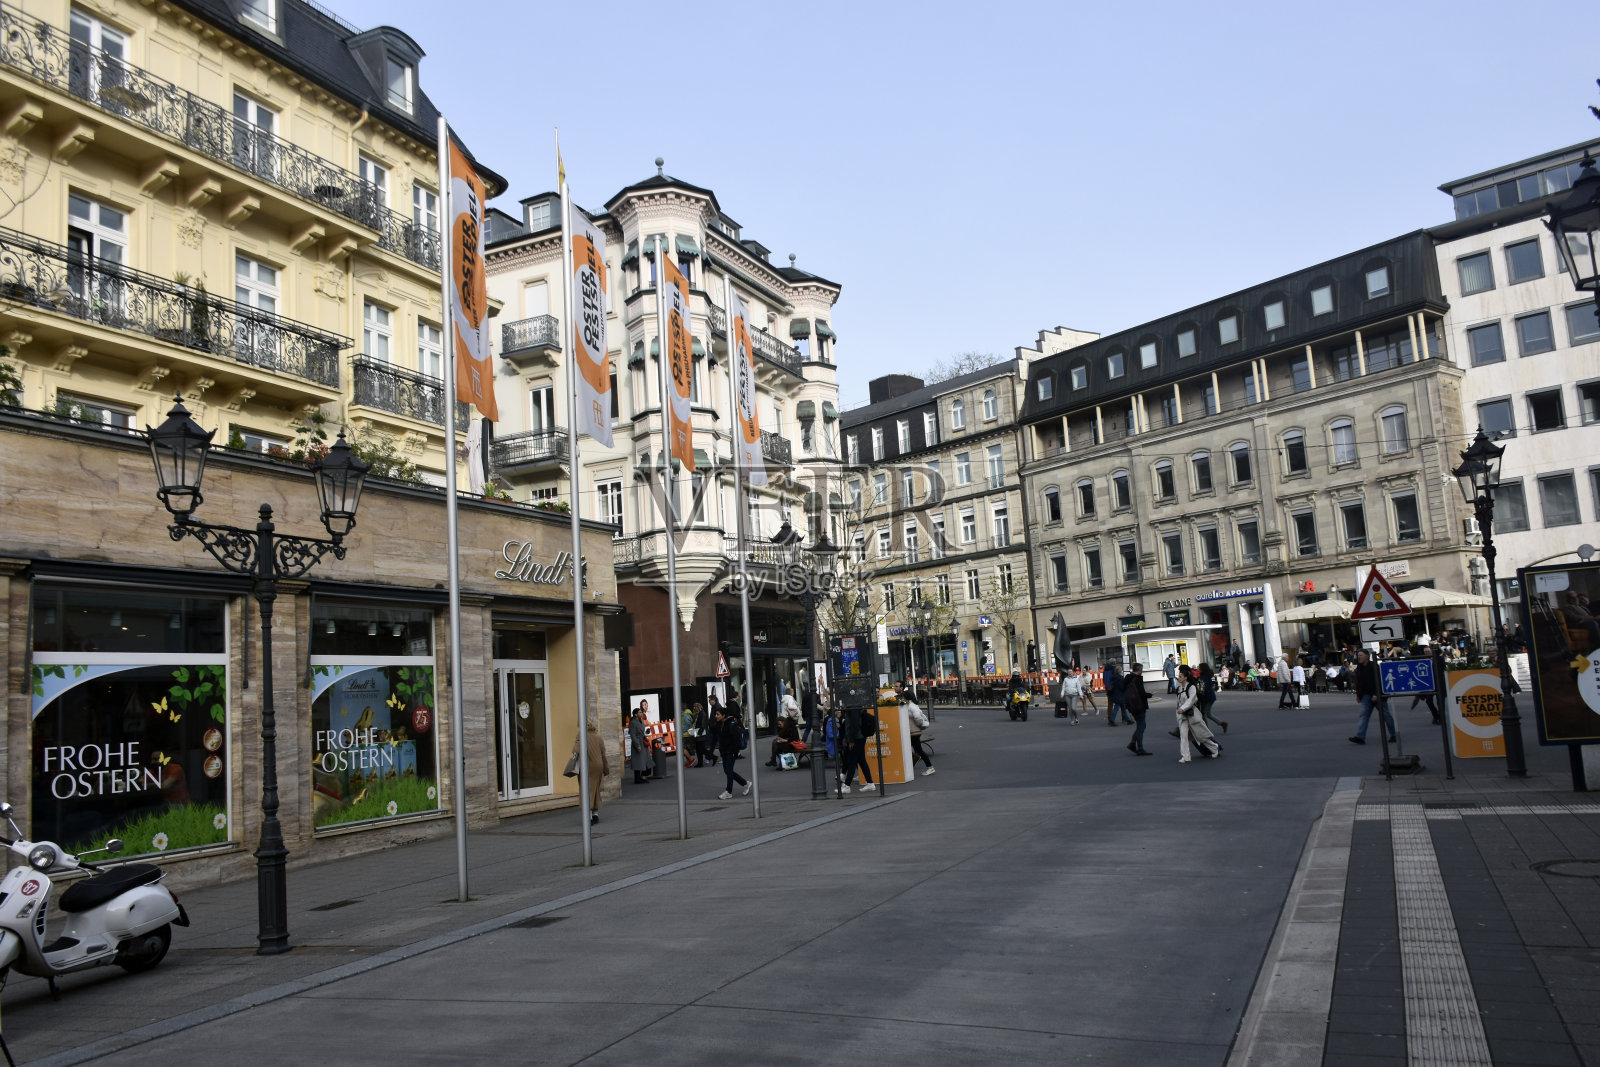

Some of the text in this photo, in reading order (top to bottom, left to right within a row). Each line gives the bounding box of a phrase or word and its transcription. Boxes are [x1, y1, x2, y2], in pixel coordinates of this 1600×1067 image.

[585, 229, 600, 353] FESTSPIELE
[581, 271, 592, 346] OSTER
[494, 540, 567, 585] Lindt
[1225, 586, 1264, 597] APOTHEK
[1455, 693, 1503, 704] FESTSPIE
[1466, 702, 1500, 713] STADT
[316, 727, 379, 751] FROHE
[44, 741, 140, 773] FROHE
[321, 747, 394, 773] OSTERN
[51, 766, 162, 800] OSTERN
